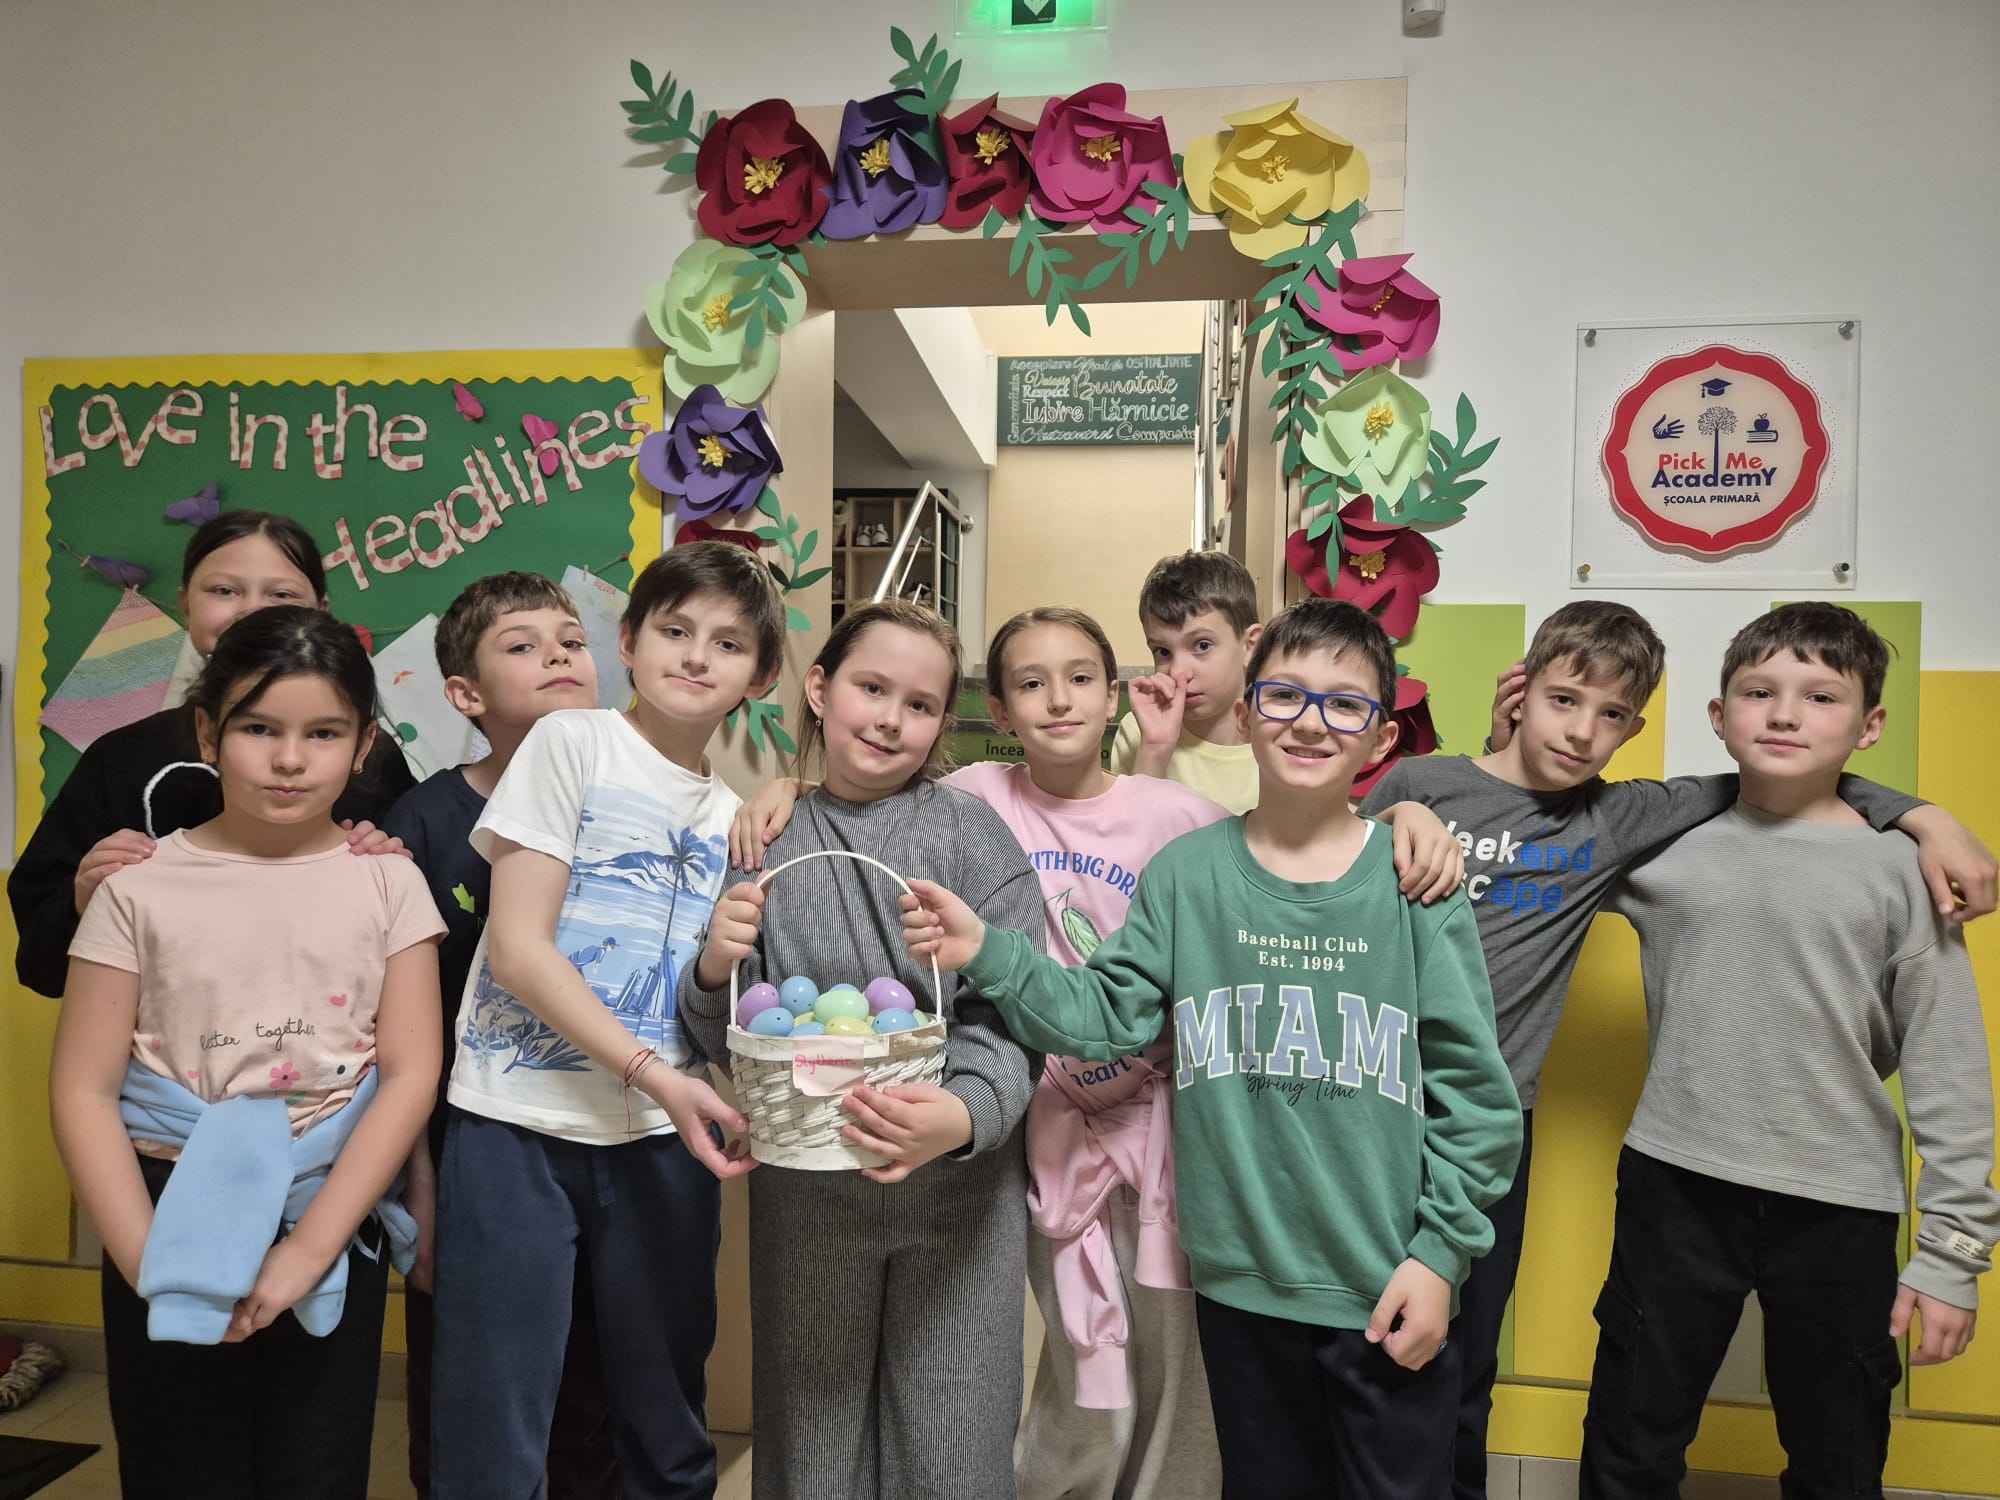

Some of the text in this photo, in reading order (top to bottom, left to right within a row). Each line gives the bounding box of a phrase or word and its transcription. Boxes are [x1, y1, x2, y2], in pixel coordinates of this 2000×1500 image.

[1022, 385, 1070, 401] Respect
[1022, 397, 1189, 424] Iubire Hărnicie
[38, 386, 428, 479] Love in the
[1658, 452, 1763, 470] Pick Me
[323, 395, 655, 590] Headlines
[1663, 492, 1760, 507] ȘCOALA PRIMARĂ
[985, 739, 1025, 757] Încea
[1447, 820, 1595, 873] eekend
[1072, 852, 1105, 879] BIG
[1105, 863, 1137, 900] DR
[1461, 873, 1563, 918] cape
[1237, 929, 1369, 953] Baseball Club
[1258, 951, 1346, 972] Est. 1994
[1247, 1064, 1359, 1106] Spring Time
